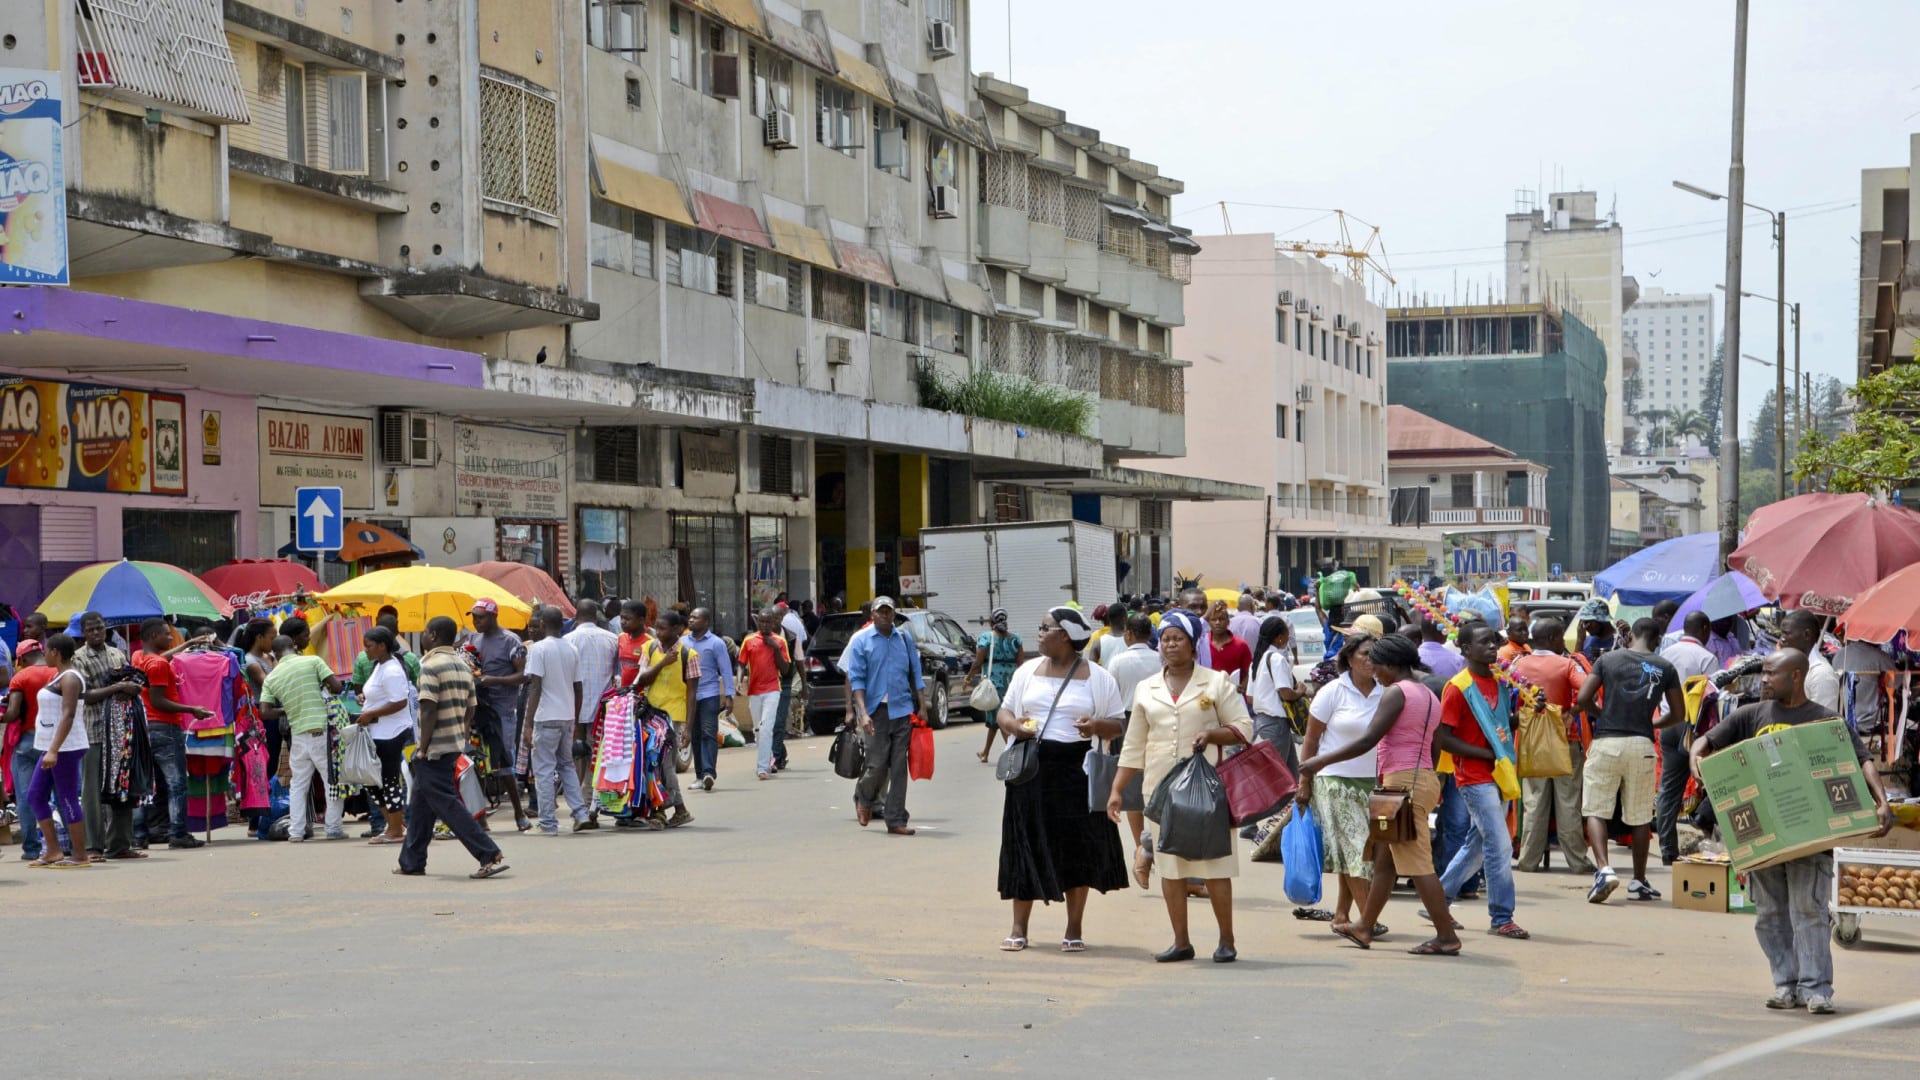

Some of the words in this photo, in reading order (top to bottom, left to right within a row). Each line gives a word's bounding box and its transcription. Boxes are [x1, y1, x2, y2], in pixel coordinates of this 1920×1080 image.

[0, 162, 51, 198] AQ
[0, 388, 40, 434] AQ
[76, 399, 131, 440] MAQ
[268, 420, 309, 450] BAZAR
[1453, 547, 1517, 576] Mila
